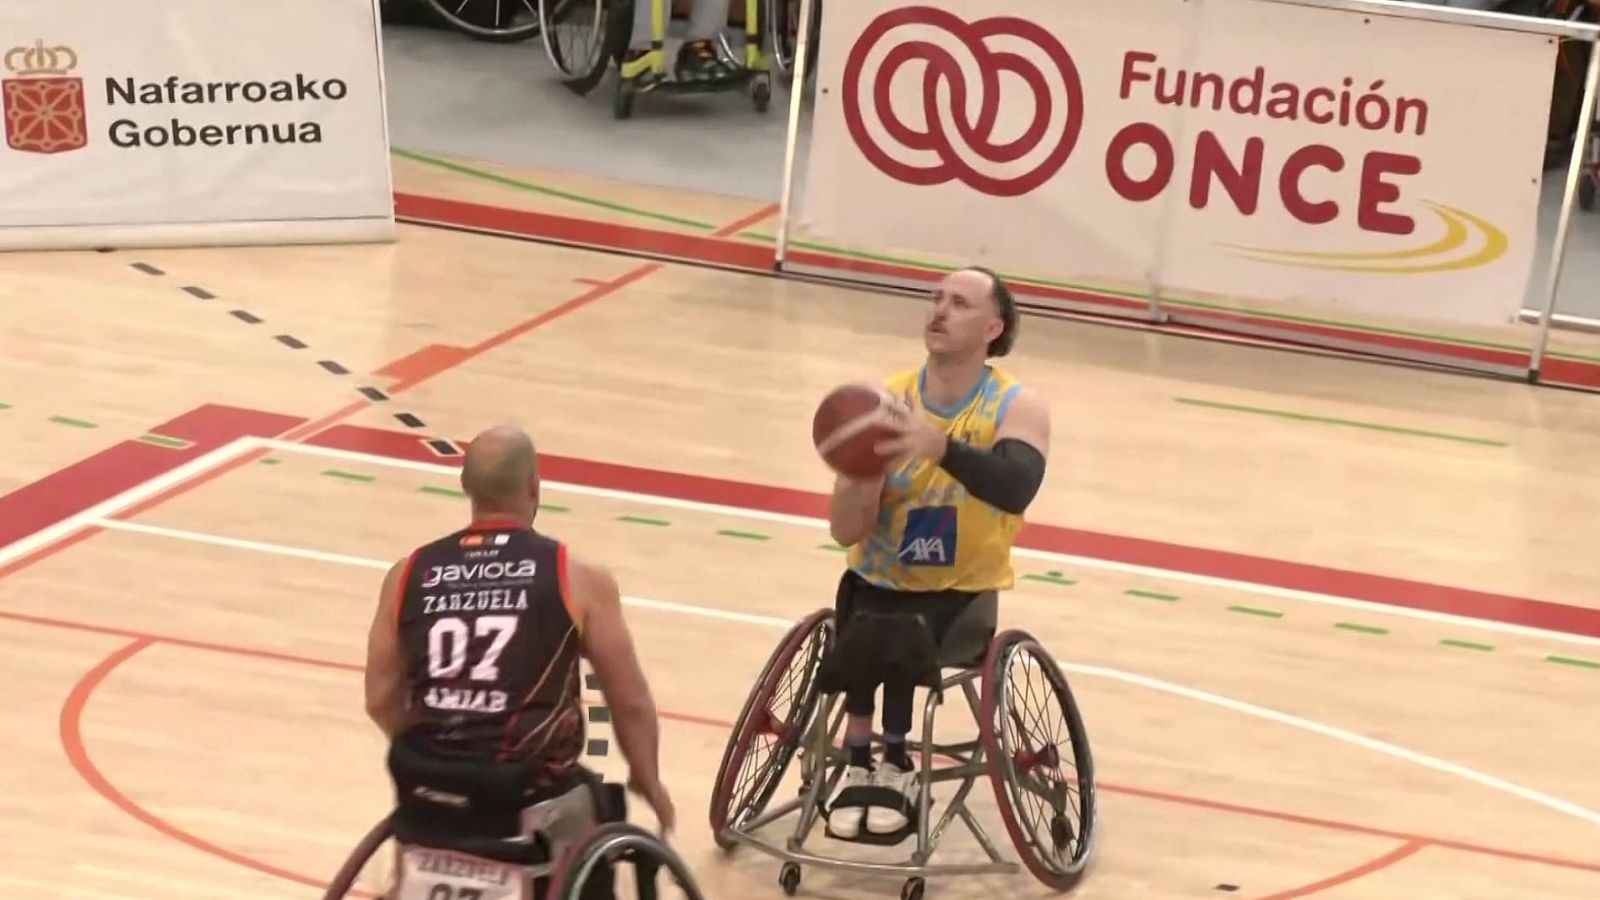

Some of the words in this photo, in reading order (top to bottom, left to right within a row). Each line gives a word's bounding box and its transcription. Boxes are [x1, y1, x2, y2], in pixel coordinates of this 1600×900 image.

[106, 73, 347, 105] Nafarroako
[1119, 50, 1428, 135] Fundación
[108, 118, 321, 148] Gobernua
[1105, 122, 1422, 235] ONCE
[898, 536, 946, 562] AXA
[422, 559, 536, 587] gaviota
[423, 589, 529, 614] ZARZUELA
[428, 615, 519, 681] 07
